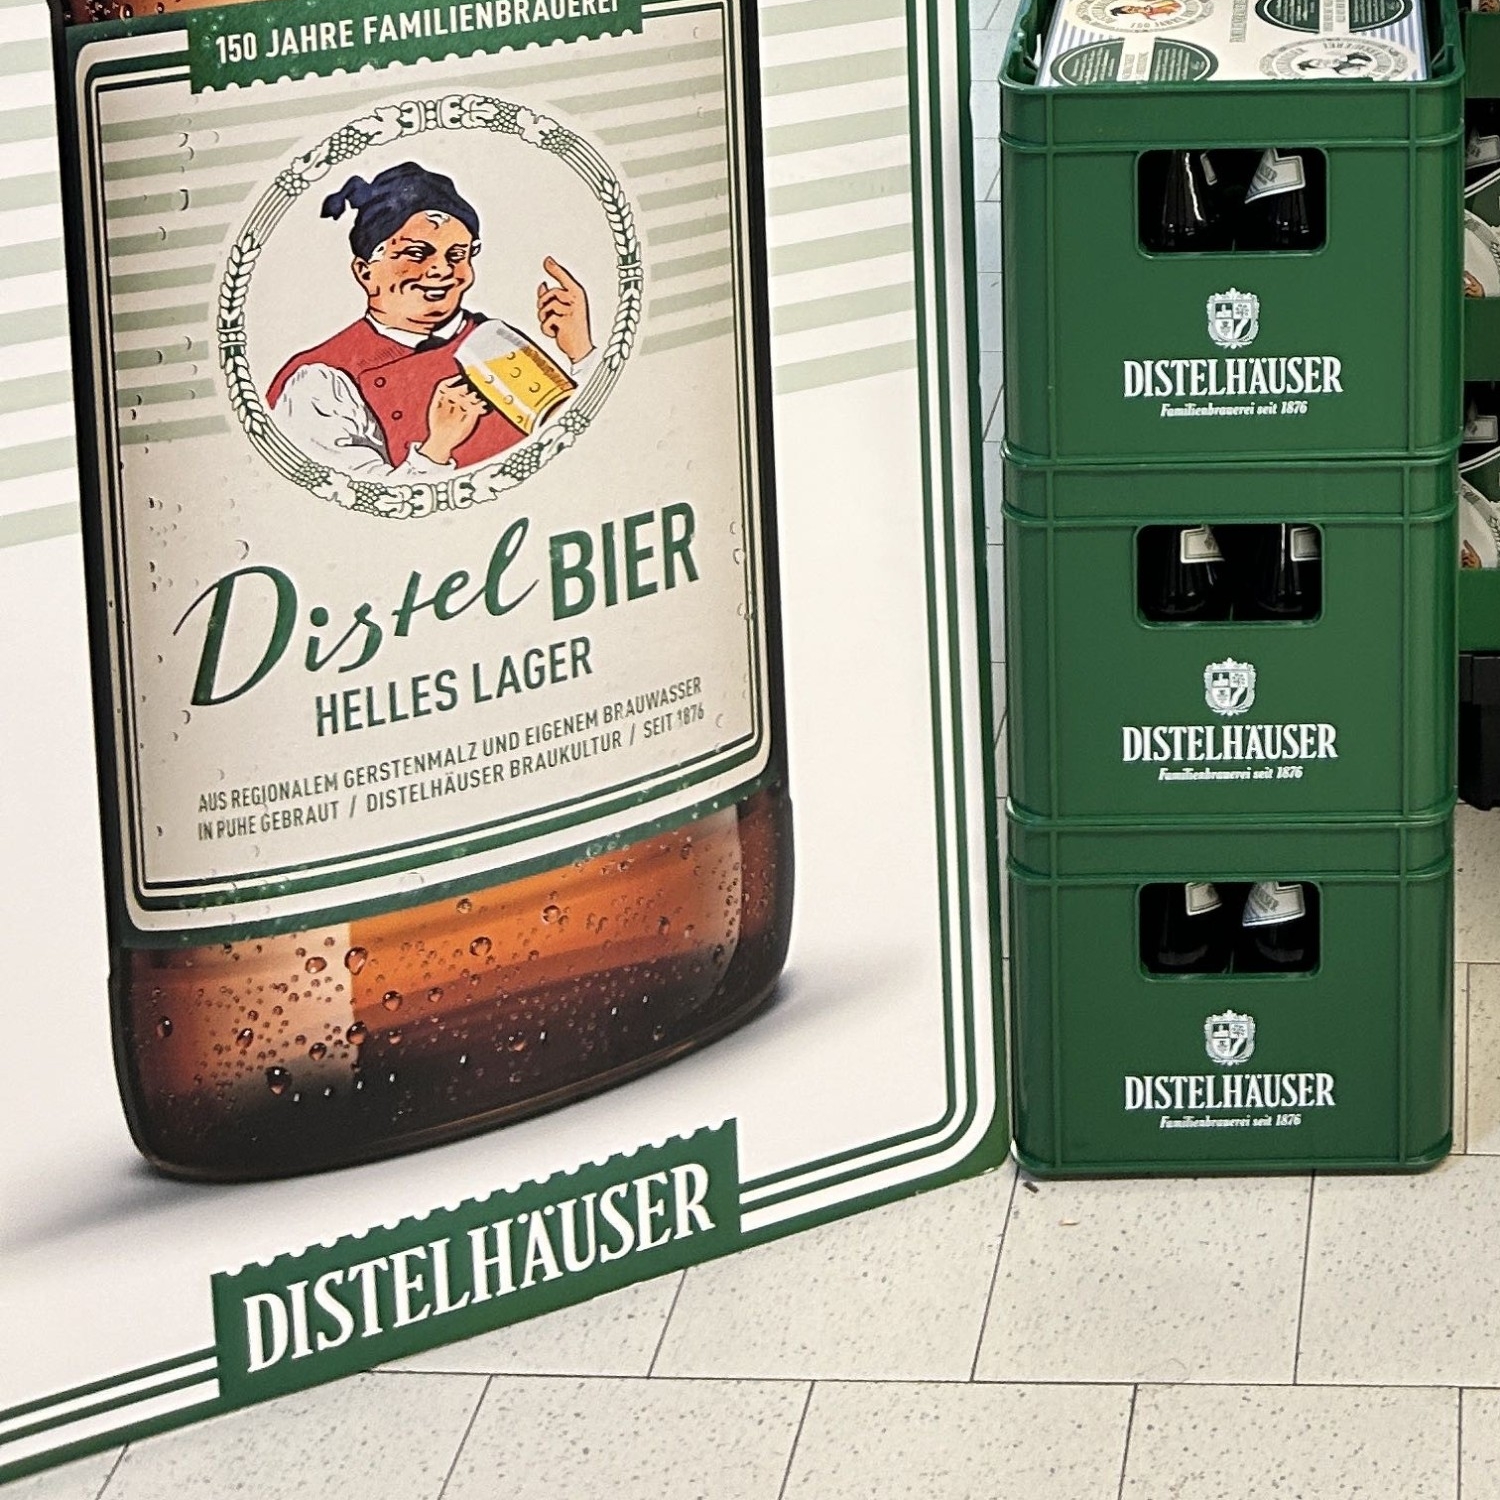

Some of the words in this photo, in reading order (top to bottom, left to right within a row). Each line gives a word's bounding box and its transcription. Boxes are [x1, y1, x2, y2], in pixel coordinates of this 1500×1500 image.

[216, 33, 257, 64] 150
[266, 21, 354, 58] JAHRE
[1123, 356, 1344, 398] DISTELHÄUSER
[1160, 402, 1255, 417] Familienbrauerei
[1257, 402, 1277, 416] seit
[1281, 401, 1308, 415] 1876
[173, 517, 540, 708] Distel
[549, 502, 700, 621] BIER
[315, 670, 458, 738] HELLES
[472, 636, 593, 704] LAGER
[198, 792, 227, 813] AUS
[232, 772, 338, 808] REGIONALEM
[344, 742, 477, 789] GERSTENMALZ
[483, 731, 520, 757] UND
[525, 709, 599, 747] EIGENEM
[603, 676, 702, 725] BRAUWASSER
[1122, 723, 1338, 762] DISTELHÄUSER
[198, 822, 213, 841] IN
[261, 800, 340, 833] GEBRAUT
[367, 764, 505, 813] DISTELHÄUSER
[510, 730, 622, 779] BRAUKULTUR
[644, 712, 673, 739] SEIT
[676, 702, 705, 728] 1876
[1124, 1073, 1336, 1110] DISTELHÄUSER
[1275, 1113, 1302, 1126] 1876
[243, 1163, 716, 1374] DISTELHÄUSER
